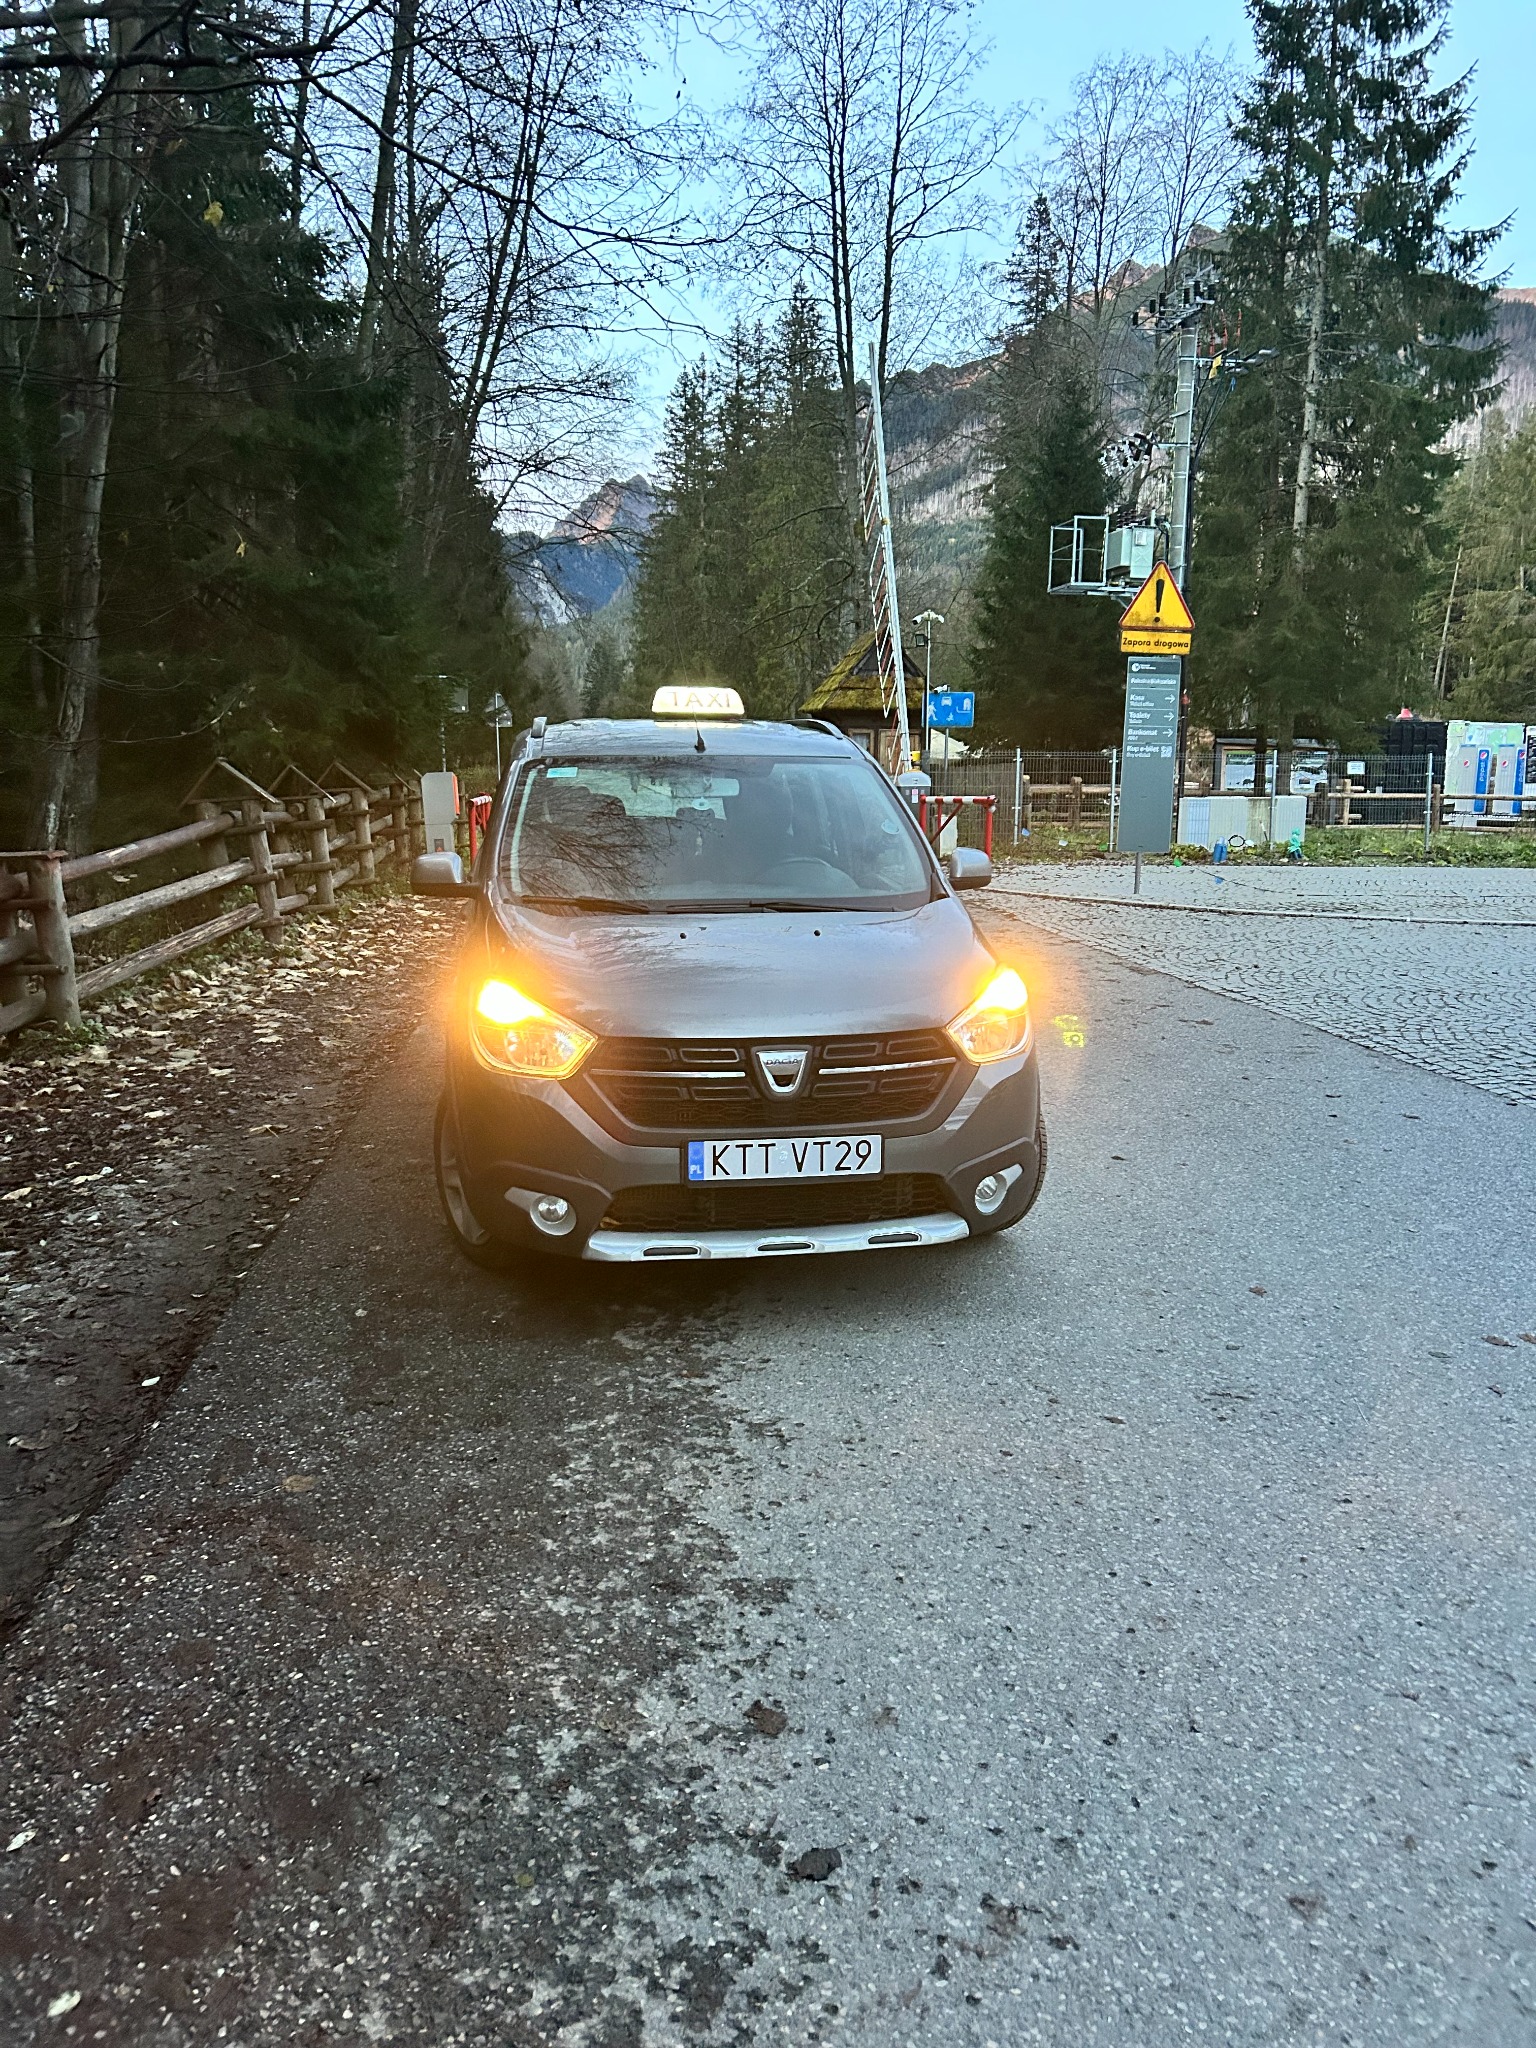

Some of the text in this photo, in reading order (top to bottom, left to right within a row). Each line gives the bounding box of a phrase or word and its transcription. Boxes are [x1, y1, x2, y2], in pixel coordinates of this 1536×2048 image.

[1122, 637, 1189, 650] Zapora drogowa
[666, 691, 730, 708] TAXI
[1129, 693, 1145, 701] Kasa
[1128, 711, 1151, 720] Toalety
[1127, 728, 1158, 736] Bankomat
[766, 1058, 799, 1066] DACIA
[712, 1139, 872, 1176] KTT VT29
[689, 1164, 703, 1175] PL
